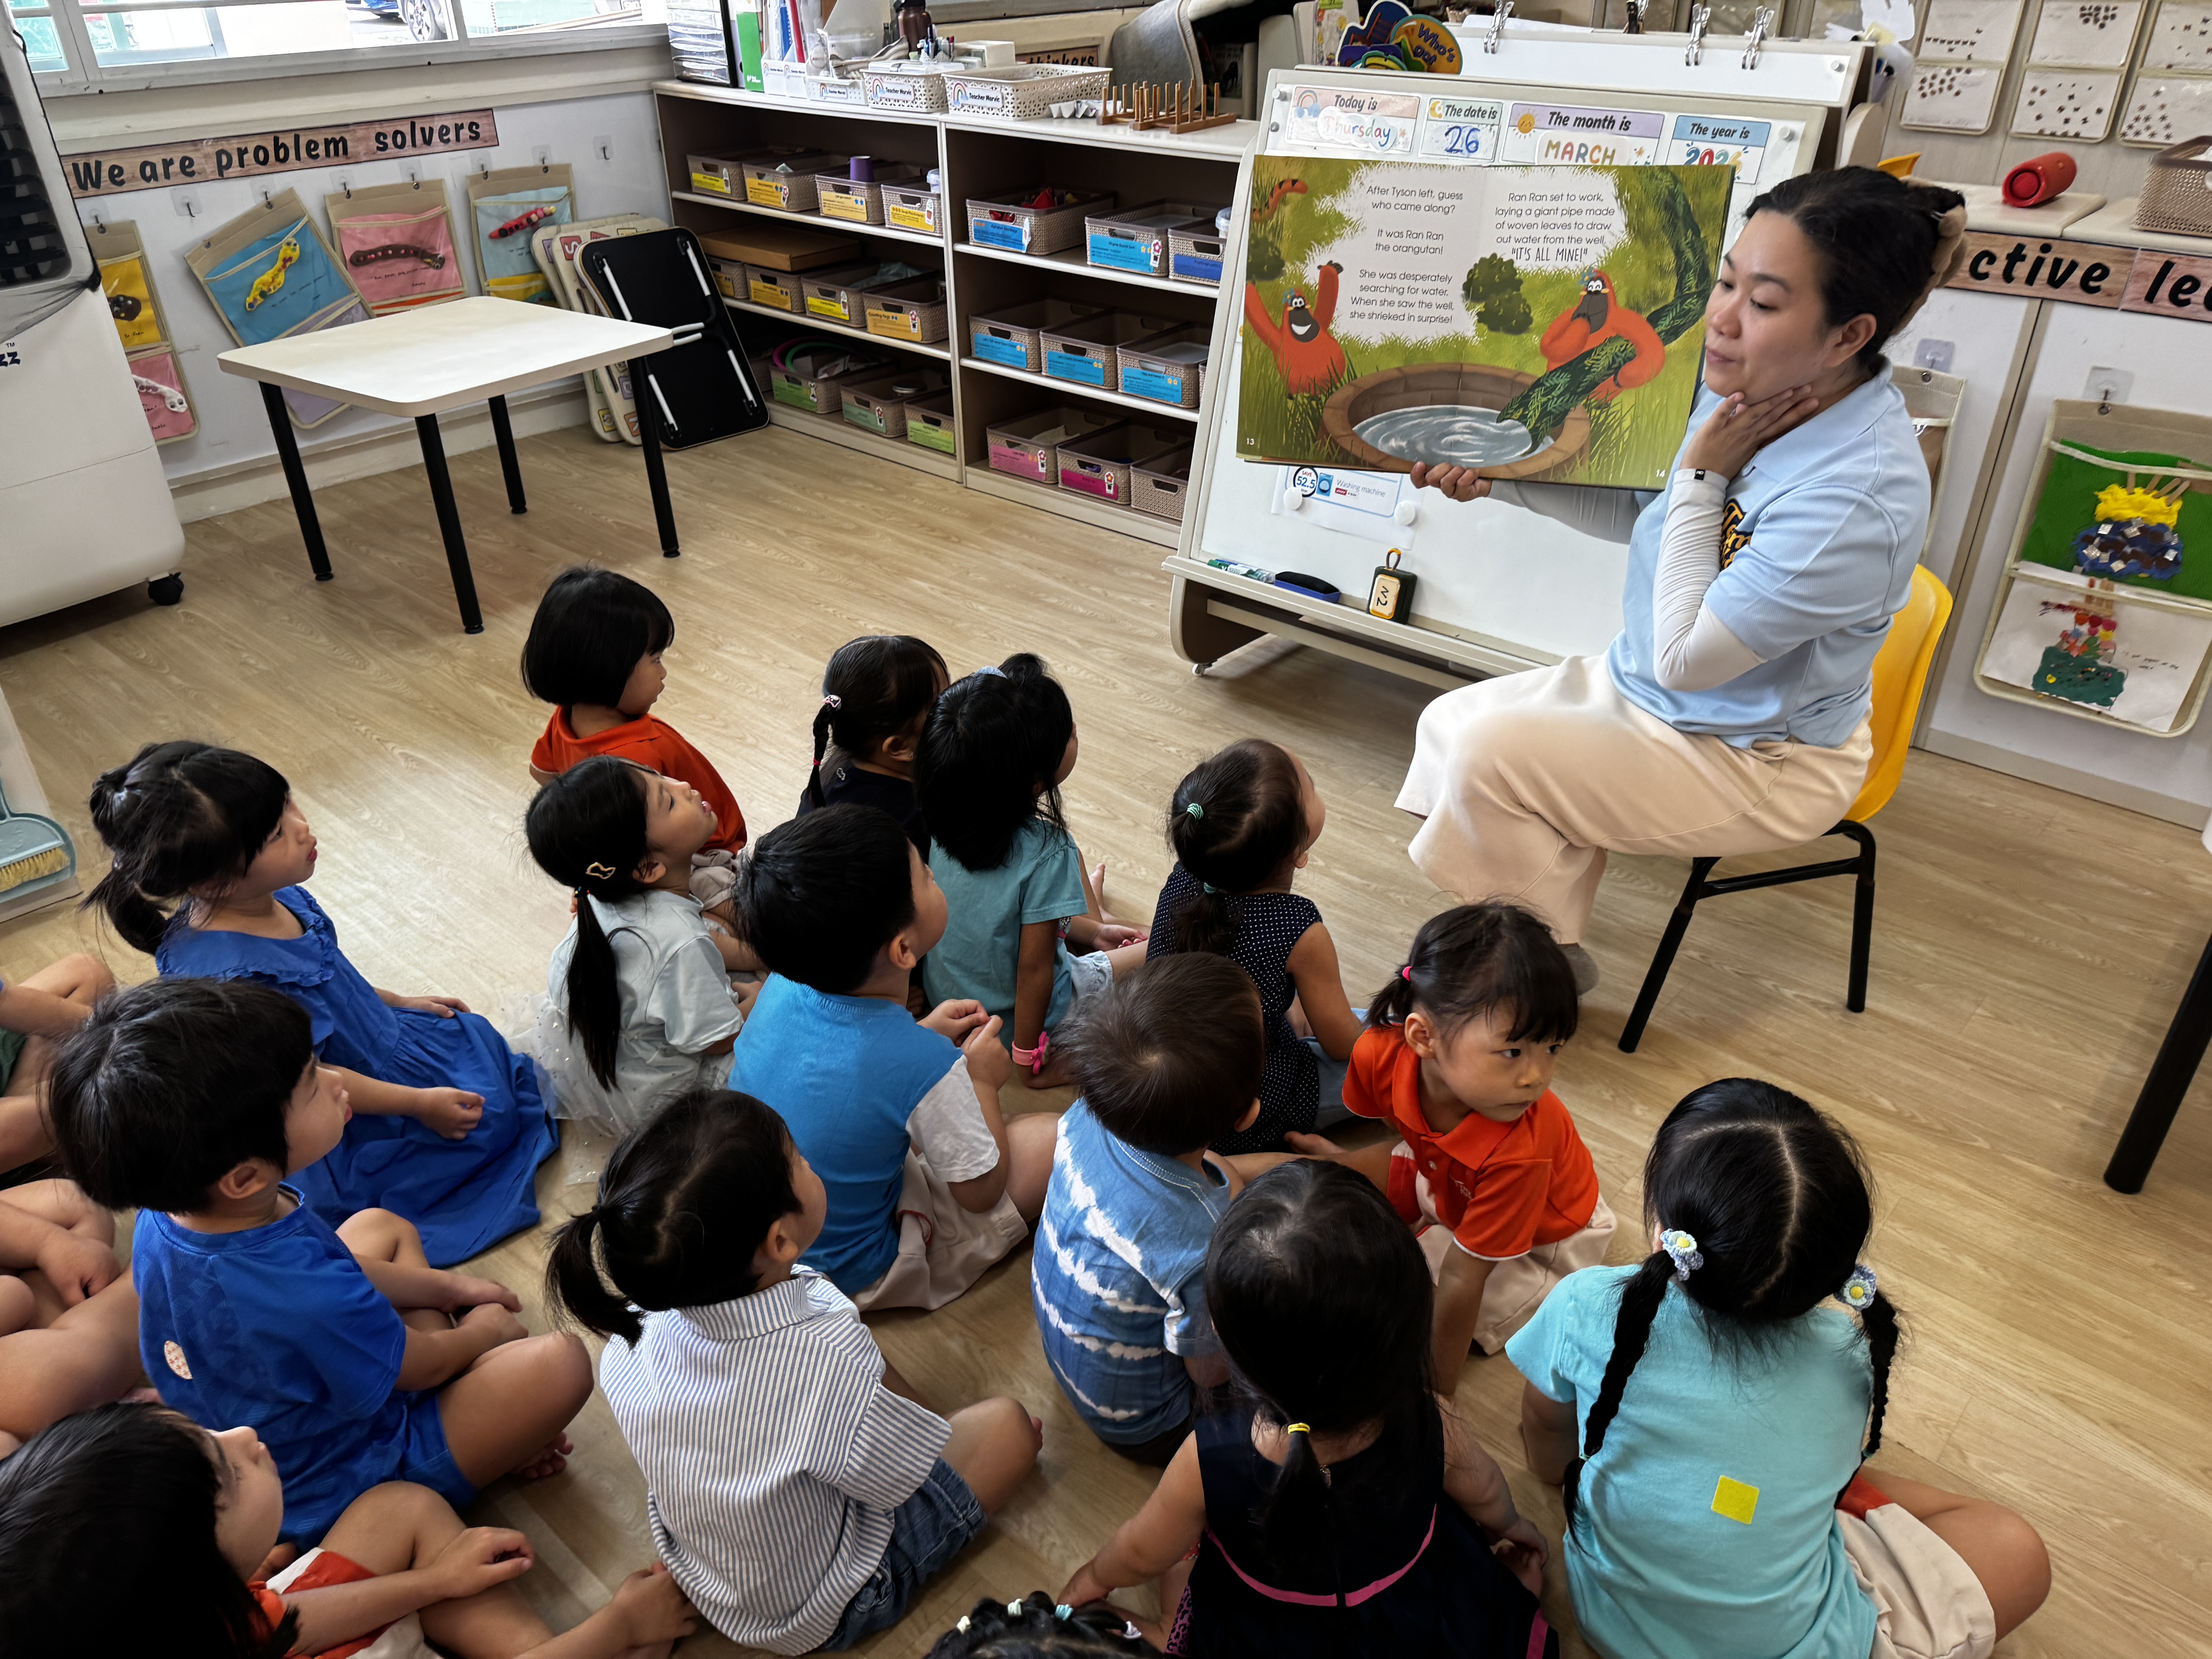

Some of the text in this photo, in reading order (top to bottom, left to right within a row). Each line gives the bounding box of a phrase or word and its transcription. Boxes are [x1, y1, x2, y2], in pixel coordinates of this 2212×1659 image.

[1418, 22, 1455, 63] Who's
[1334, 94, 1378, 112] Today is
[1445, 105, 1498, 119] The date is
[1548, 111, 1632, 131] The month is
[1323, 116, 1391, 147] Thursday
[1690, 122, 1751, 139] The year is
[1445, 125, 1480, 153] 26
[71, 121, 481, 191] We are problem solvers
[1544, 139, 1616, 165] MARCH
[1366, 185, 1389, 194] After
[1391, 187, 1417, 198] Tyson
[1438, 191, 1463, 201] guess
[1508, 192, 1604, 202] Ran Ran set to work,
[1372, 200, 1455, 215] who came along?
[1495, 206, 1523, 218] laying
[1534, 206, 1559, 218] giant
[1561, 208, 1583, 218] pipe
[1585, 207, 1615, 216] made
[1495, 220, 1506, 230] of
[1540, 221, 1571, 230] leaves
[1574, 221, 1584, 230] to
[1586, 221, 1612, 230] draw
[1377, 228, 1444, 241] It was Ran Ran
[1496, 235, 1606, 245] out water from the well.
[1375, 242, 1443, 255] the orangutan!
[1535, 247, 1550, 262] ALL
[1359, 269, 1376, 278] She
[1399, 271, 1453, 285] desperately
[1969, 242, 2212, 311] ctive le
[1359, 284, 1405, 296] searching
[1407, 285, 1419, 295] for
[1351, 296, 1377, 306] When
[1379, 298, 1395, 307] she
[1418, 300, 1433, 309] the
[1350, 310, 1453, 325] she shrieked in surprise!
[1656, 469, 1666, 477] 14
[1296, 476, 1316, 489] 52.5
[1336, 479, 1360, 493] Washing
[1361, 486, 1386, 498] machine
